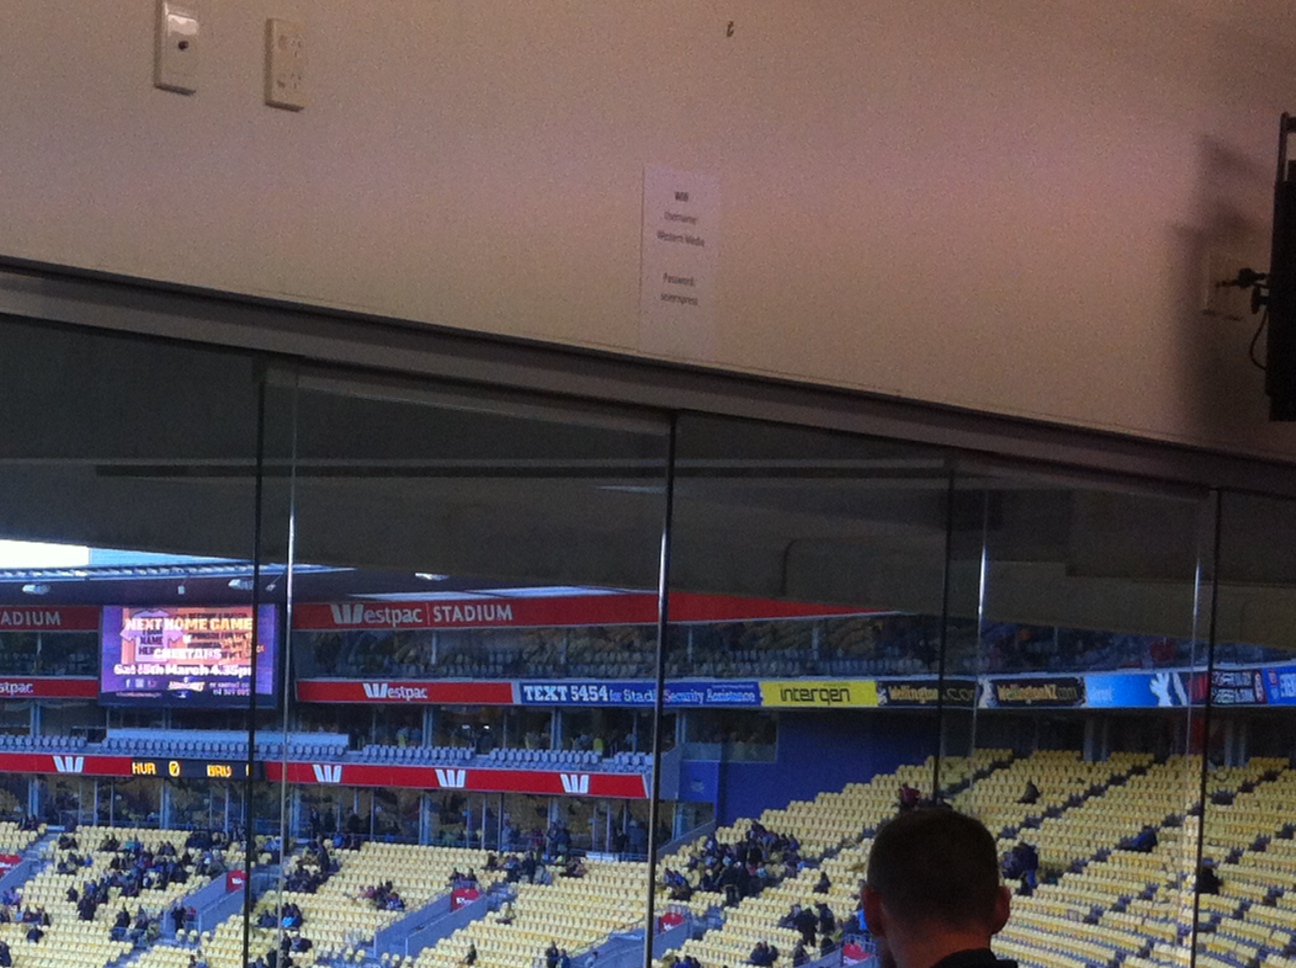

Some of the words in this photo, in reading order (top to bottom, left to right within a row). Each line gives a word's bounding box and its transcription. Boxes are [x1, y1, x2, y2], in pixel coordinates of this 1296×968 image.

[125, 619, 162, 631] NEXT
[163, 618, 208, 631] HOME
[209, 618, 253, 631] GAME
[330, 604, 423, 627] Westpac
[433, 604, 513, 622] STADIUM
[165, 664, 209, 676] March
[363, 682, 428, 701] Westpac
[524, 685, 568, 701] TEXT
[570, 685, 608, 701] 5454
[624, 688, 658, 702] Stadi
[663, 688, 705, 704] Security
[780, 686, 850, 705] intergen
